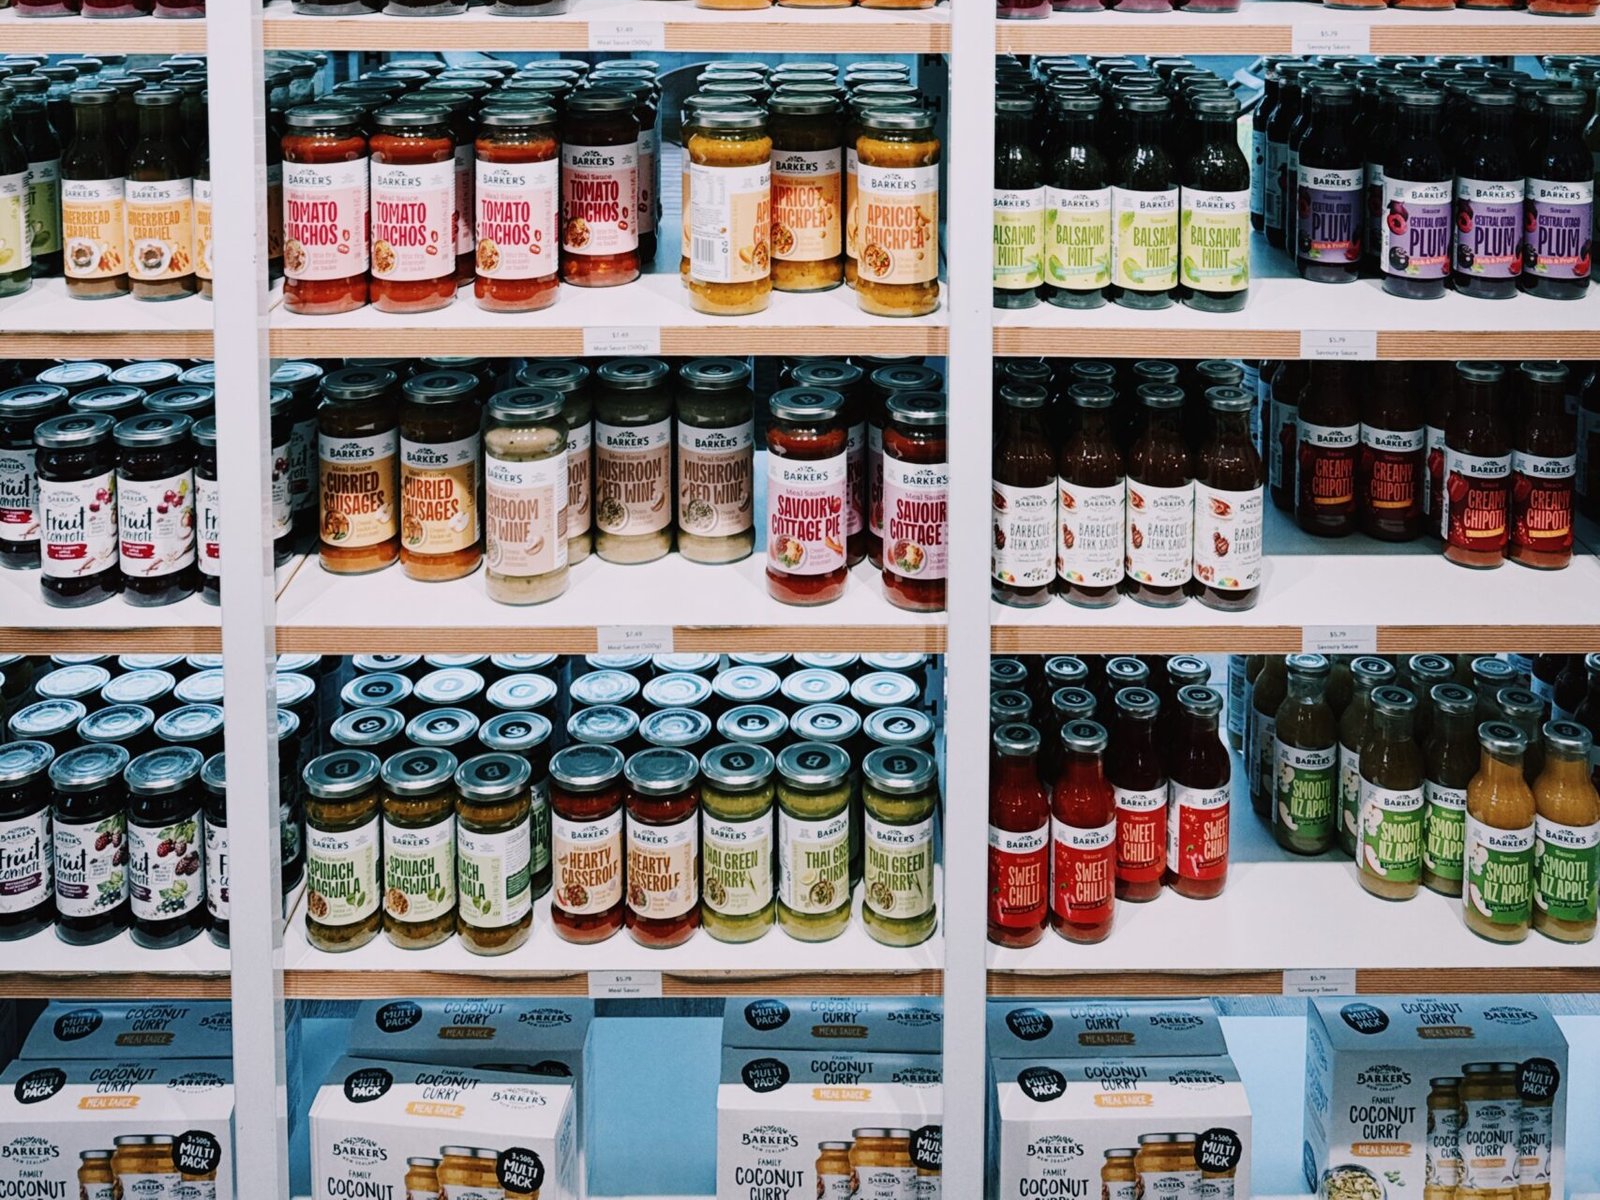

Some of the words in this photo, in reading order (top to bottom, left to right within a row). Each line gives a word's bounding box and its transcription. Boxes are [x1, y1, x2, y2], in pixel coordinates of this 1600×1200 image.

[572, 156, 615, 167] BARKER'S
[776, 161, 818, 172] BARKER'S
[288, 175, 332, 186] BARKER'S
[871, 179, 916, 189] BARKER'S
[132, 190, 170, 198] BARKER'S
[570, 181, 619, 201] TOMATO
[287, 200, 337, 223] TOMATO
[481, 200, 530, 222] TOMATO
[867, 204, 921, 227] APRICOT
[1056, 225, 1104, 246] BALSAMIC
[1190, 225, 1241, 248] BALSAMIC
[1409, 228, 1446, 258] PLUM
[1474, 228, 1515, 257] PLUM
[1067, 247, 1095, 266] MINT
[1202, 249, 1229, 268] MINT
[607, 436, 649, 447] BARKER'S
[1375, 438, 1412, 448] BARKER'S
[330, 448, 374, 458] BARKER'S
[597, 458, 661, 482] MUSHROOM
[783, 470, 828, 481] BARKER'S
[1373, 460, 1413, 482] CREAMY
[327, 471, 379, 494] CURRIED
[602, 482, 621, 502] RED
[625, 481, 656, 503] WINE
[1371, 479, 1413, 500] CHIPOTLE
[324, 491, 384, 516] SAUSAGES
[778, 494, 831, 520] SAVOURY
[1531, 489, 1570, 510] CREAMY
[771, 519, 822, 541] COTTAGE
[825, 516, 840, 538] PIE
[1527, 508, 1571, 531] CHIPOTLE
[571, 828, 609, 839] BARKER'S
[1073, 835, 1109, 844] BARKER'S
[1123, 822, 1156, 843] SWEET
[1545, 829, 1586, 844] BARKER'S
[569, 846, 612, 869] HEARTY
[869, 846, 887, 868] THAI
[891, 850, 924, 872] GREEN
[1123, 842, 1155, 861] CHILLI
[309, 858, 354, 881] SPINACH
[390, 855, 434, 878] SPINACH
[562, 862, 618, 886] CASSEROLE
[1075, 860, 1108, 881] SWEET
[1486, 861, 1529, 884] SMOOTH
[1543, 854, 1588, 883] SMOOTH
[1076, 881, 1108, 903] CHILLI
[1483, 882, 1499, 902] NZ
[1501, 882, 1530, 903] APPLE
[1541, 877, 1555, 897] NZ
[1557, 879, 1589, 901] APPLE
[822, 1012, 858, 1024] CURRY
[1149, 1016, 1204, 1026] BARKER'S
[90, 1068, 157, 1081] COCONUT
[811, 1060, 873, 1074] COCONUT
[168, 1078, 225, 1088] BARKER'S
[1356, 1071, 1412, 1085] BARKER'S
[1522, 1070, 1553, 1085] MULTI
[352, 1086, 381, 1098] PACK
[1371, 1096, 1395, 1104] FAMILY
[1349, 1105, 1416, 1124] COCONUT
[741, 1133, 798, 1147] BARKER'S
[1363, 1124, 1402, 1139] CURRY
[180, 1145, 215, 1159] MULTI
[333, 1143, 388, 1160] BARKER'S
[1027, 1143, 1085, 1156] BARKER'S
[1202, 1140, 1236, 1156] MULTI
[1359, 1145, 1381, 1154] MEAL
[1382, 1145, 1405, 1154] SAUCE
[180, 1157, 209, 1169] PACK
[504, 1160, 538, 1178] MULTI
[1202, 1153, 1230, 1167] PACK
[348, 1170, 371, 1179] FAMILY
[505, 1173, 532, 1188] PACK
[735, 1167, 804, 1187] COCONUT
[1019, 1178, 1090, 1197] COCONUT
